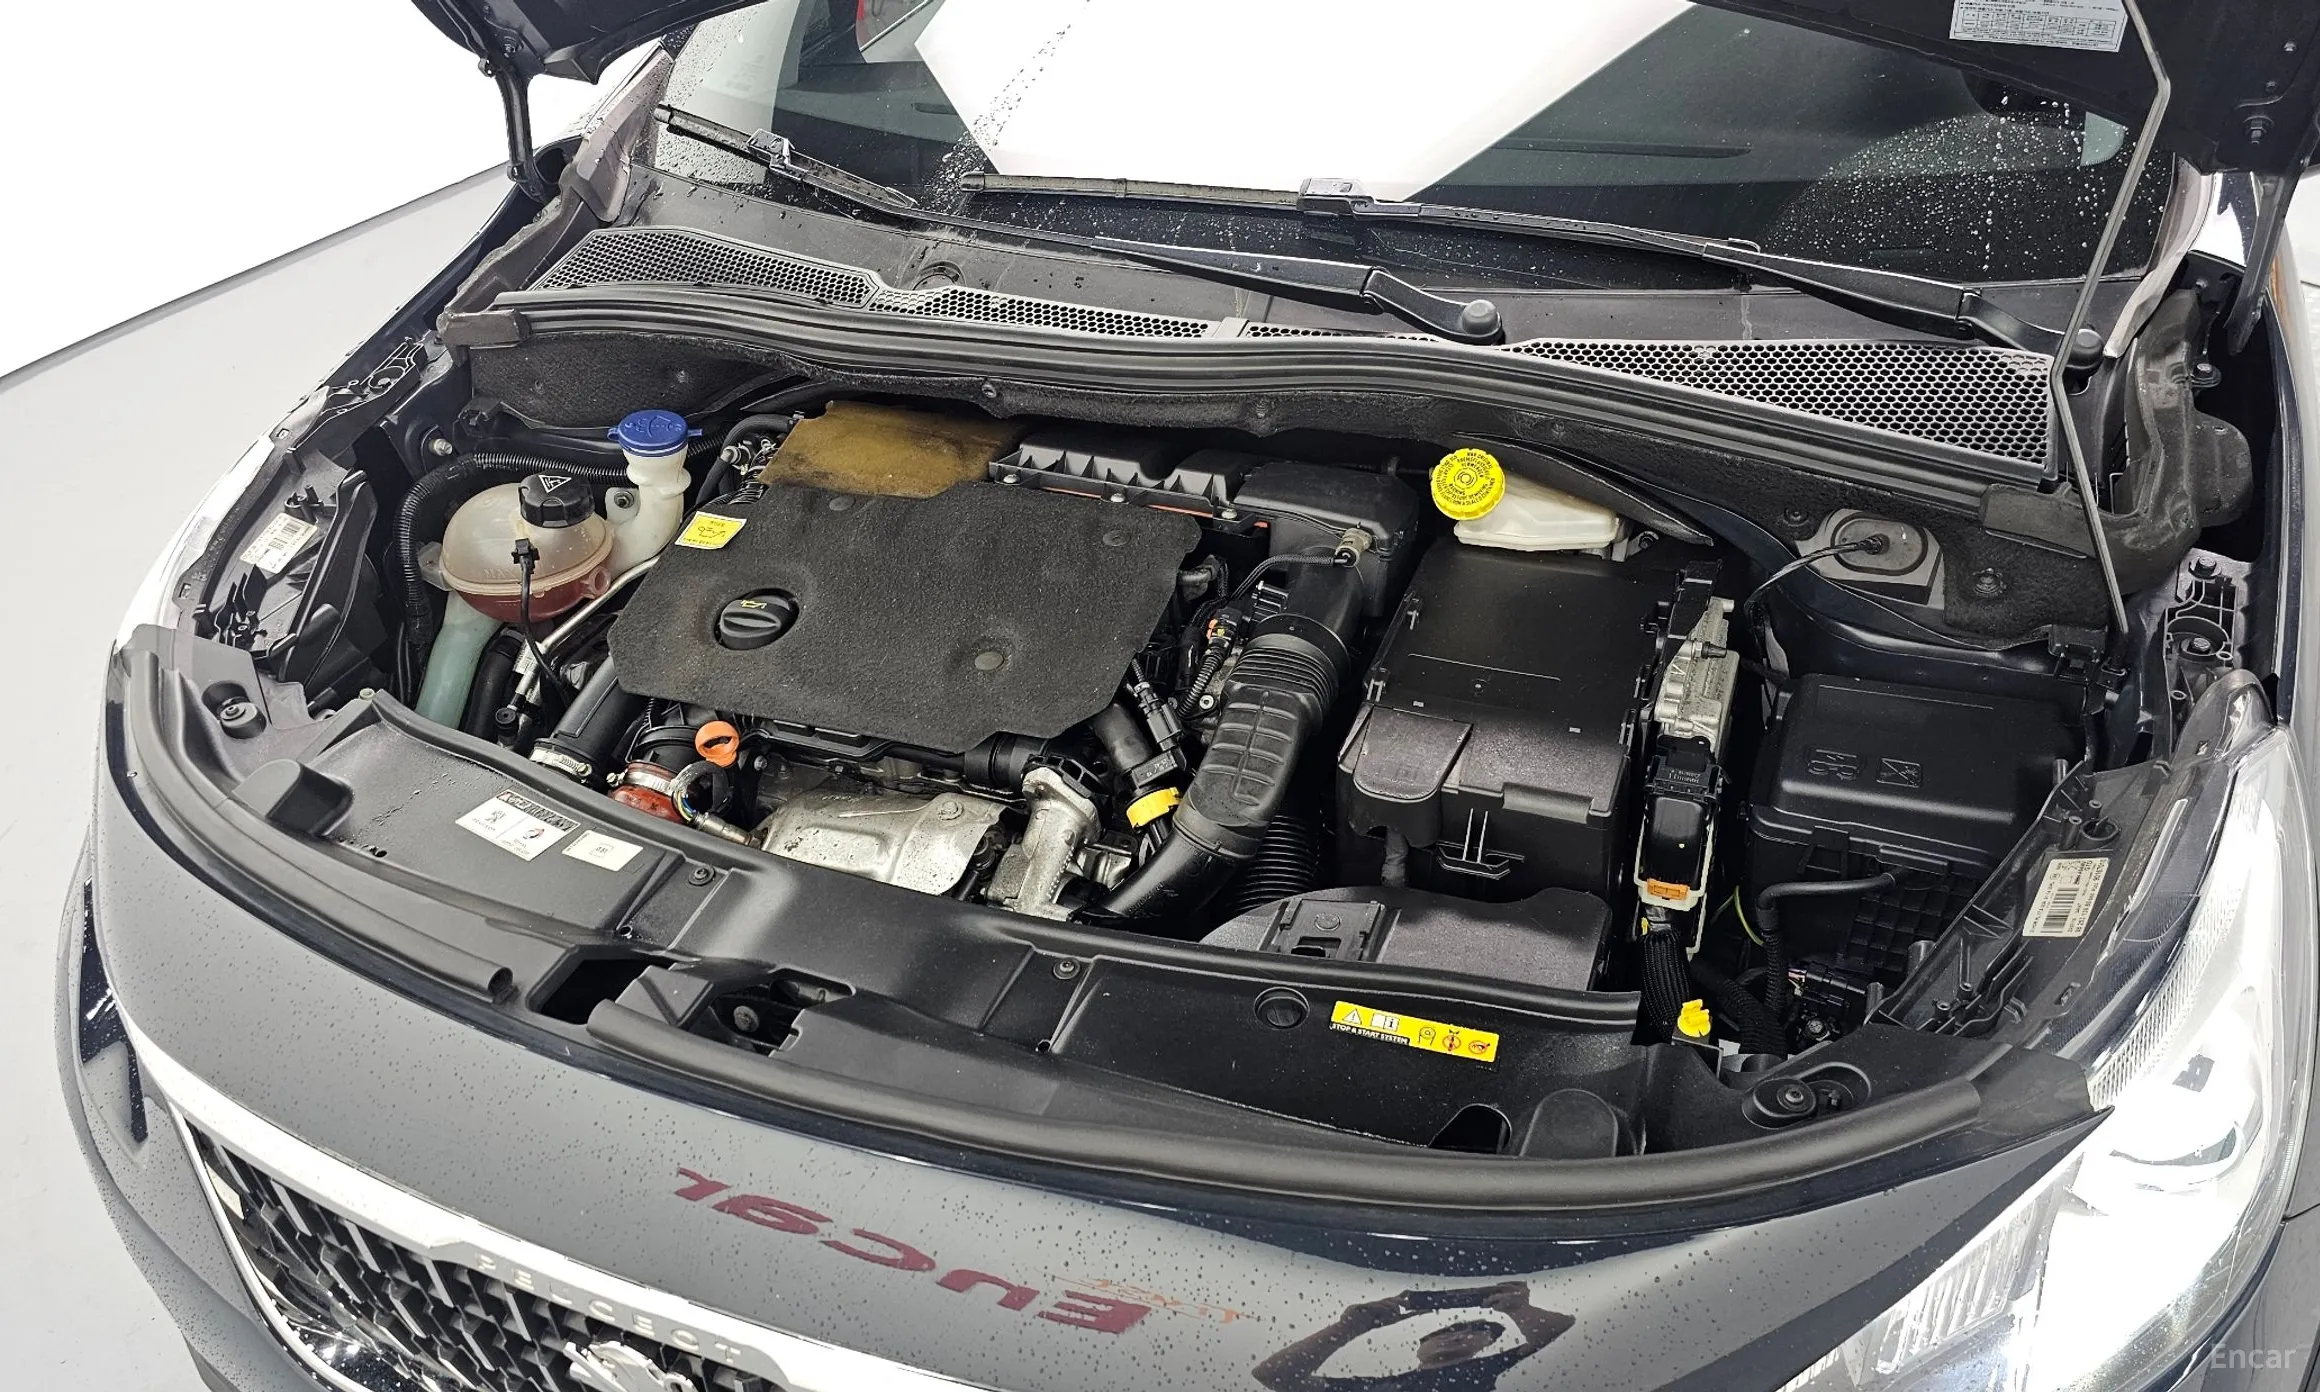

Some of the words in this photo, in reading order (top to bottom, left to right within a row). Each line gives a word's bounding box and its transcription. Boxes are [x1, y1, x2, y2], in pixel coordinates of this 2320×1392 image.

[1332, 1023, 1351, 1033] STOP
[1358, 1028, 1380, 1039] START
[1380, 1032, 1409, 1045] SYSTEM
